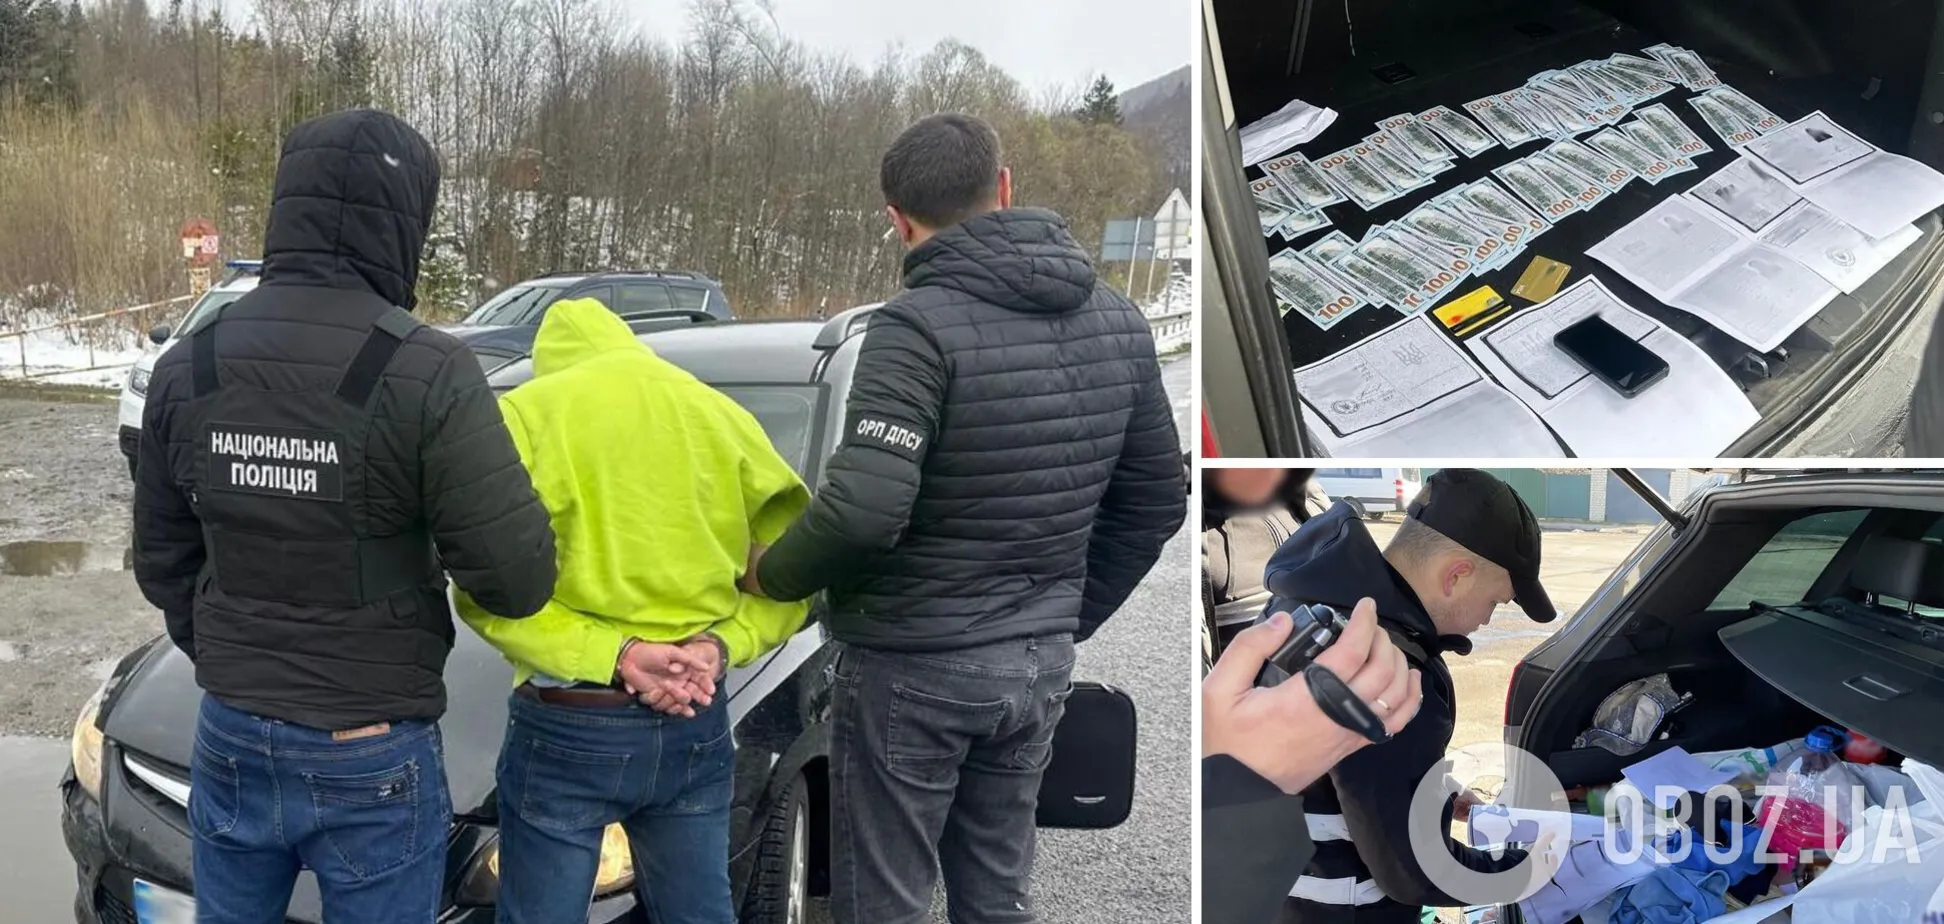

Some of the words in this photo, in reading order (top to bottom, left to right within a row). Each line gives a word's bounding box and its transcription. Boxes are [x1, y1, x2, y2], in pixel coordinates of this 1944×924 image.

[1693, 79, 1718, 89] 100
[1603, 104, 1624, 117] 100
[1755, 117, 1778, 130] 100
[1729, 131, 1754, 144] 100
[1678, 141, 1703, 154] 100
[1268, 157, 1300, 170] 100
[1320, 153, 1350, 169] 100
[1645, 161, 1669, 177] 100
[1605, 169, 1630, 186] 100
[1577, 186, 1601, 204] 100
[1547, 199, 1575, 216] 100
[1475, 238, 1499, 260] 100
[1422, 271, 1454, 293] 100
[1317, 295, 1355, 320] 100
[857, 419, 887, 438] ОРП
[883, 425, 924, 451] ДПСУ
[211, 431, 339, 464] НАЦІОНАЛЬНА
[231, 462, 317, 494] ПОЛІЦІЯ
